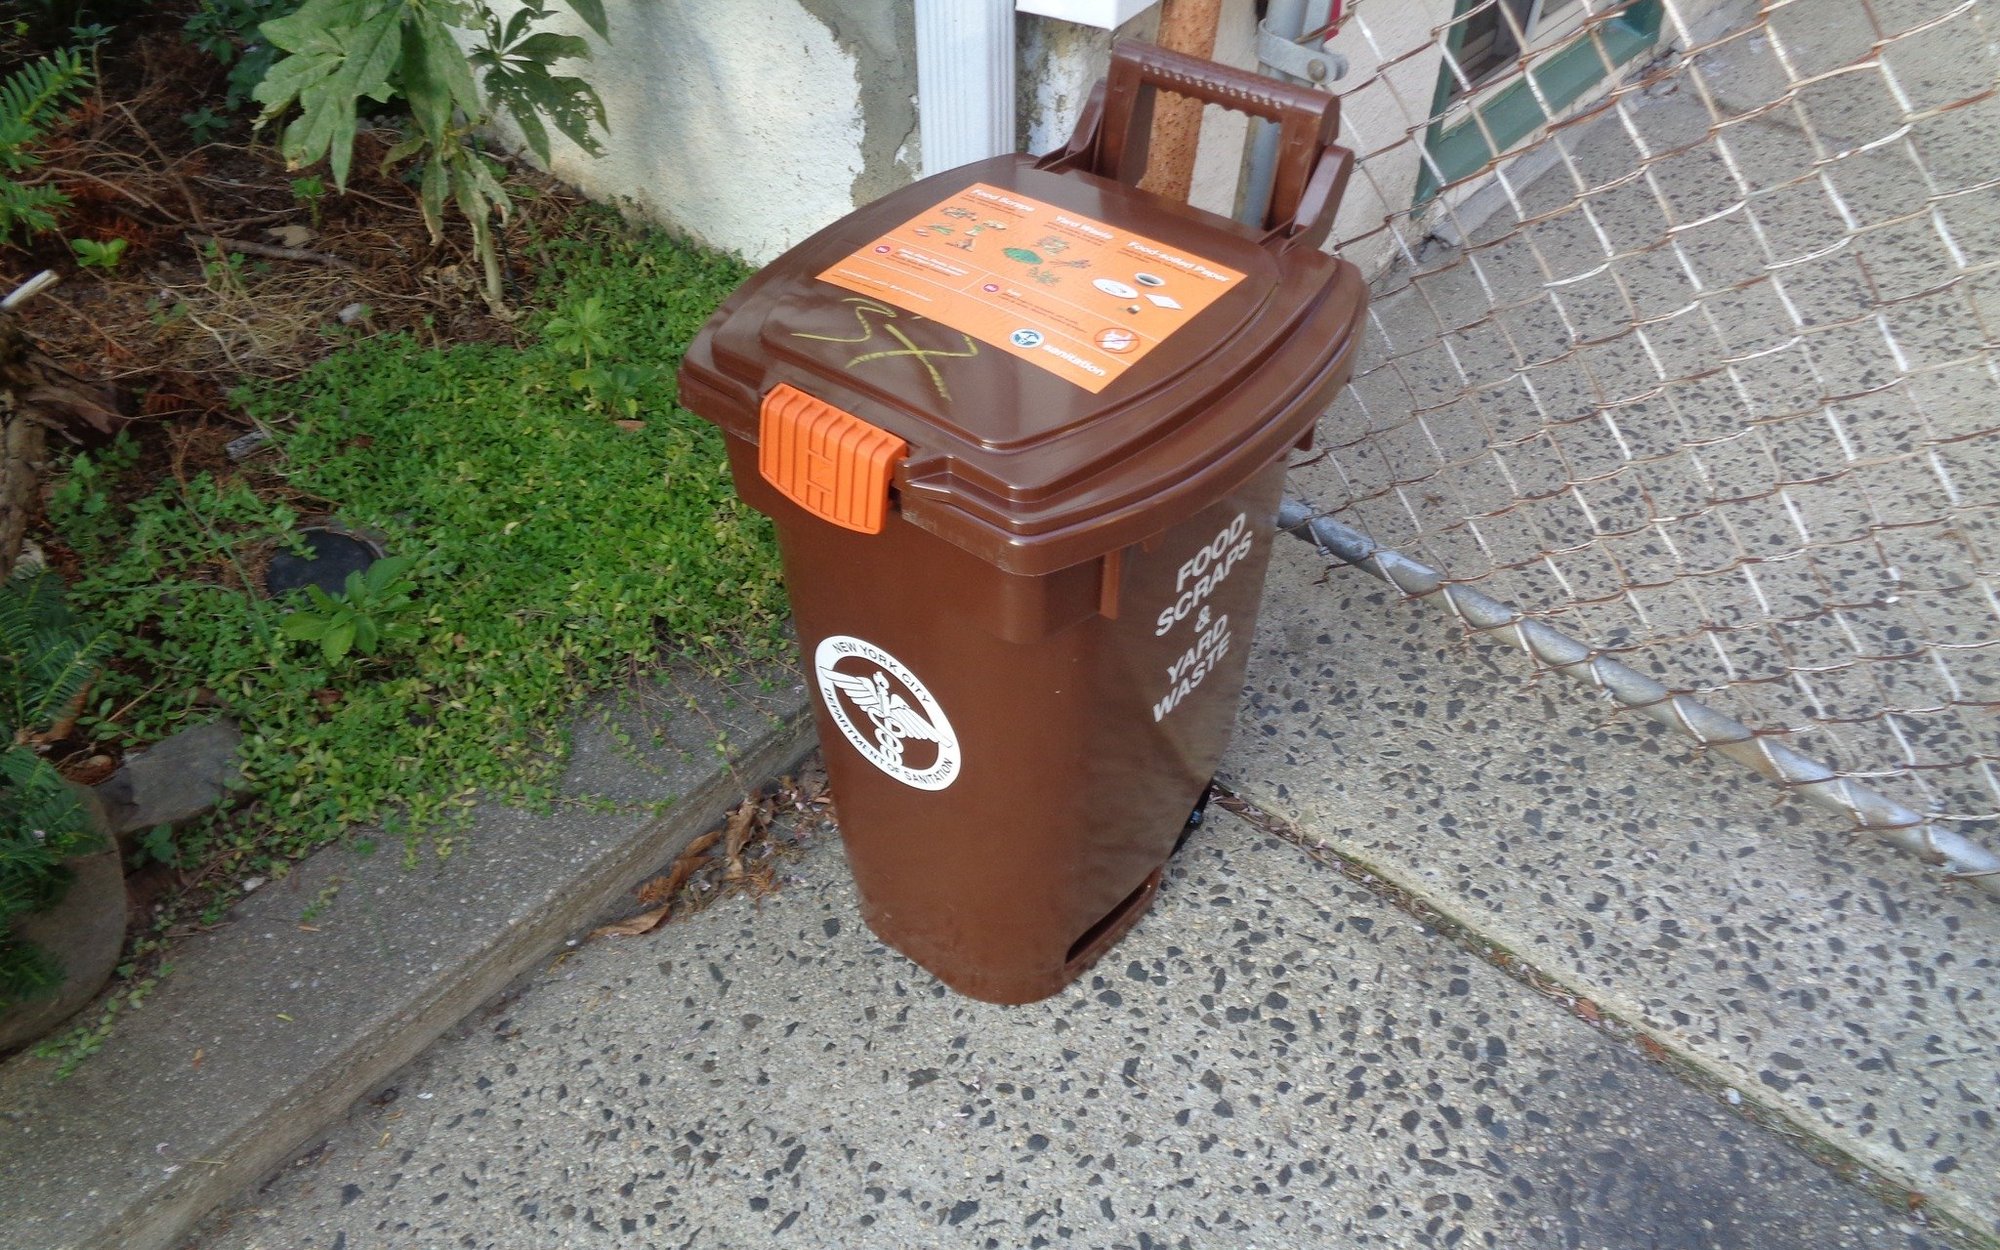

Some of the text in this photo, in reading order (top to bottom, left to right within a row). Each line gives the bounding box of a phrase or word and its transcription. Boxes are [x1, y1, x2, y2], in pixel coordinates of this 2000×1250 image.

[1194, 264, 1230, 282] Paper
[1042, 344, 1106, 377] sanitation
[1155, 530, 1253, 637] SCRAPS
[1175, 512, 1247, 593] FOOD
[1167, 614, 1228, 684] YARD
[1194, 605, 1211, 633] &
[832, 641, 931, 704] NEW YORK CITY
[1153, 631, 1232, 723] WASTE
[823, 687, 953, 784] DEPARTMENT OF SANITATION
